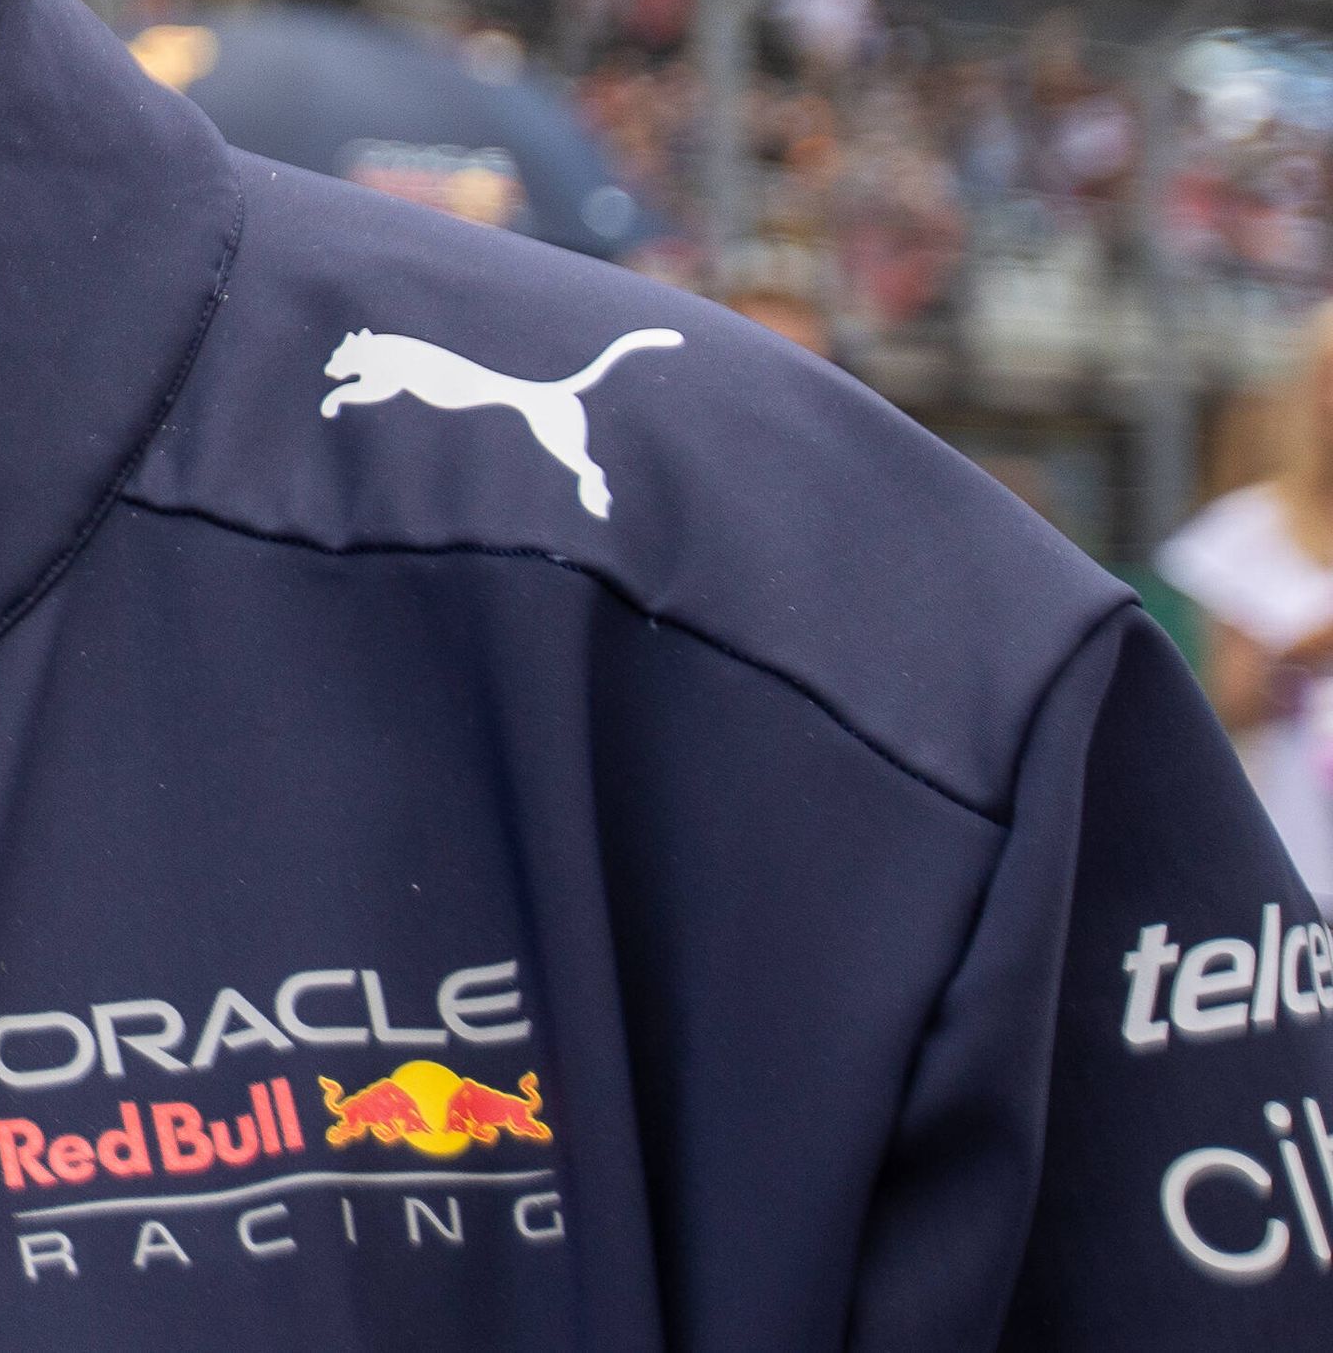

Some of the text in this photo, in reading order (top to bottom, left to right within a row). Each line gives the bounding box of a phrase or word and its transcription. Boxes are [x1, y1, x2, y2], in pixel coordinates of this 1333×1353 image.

[1121, 902, 1333, 1047] telce
[150, 1076, 306, 1174] Bull
[17, 1191, 565, 1282] RACING
